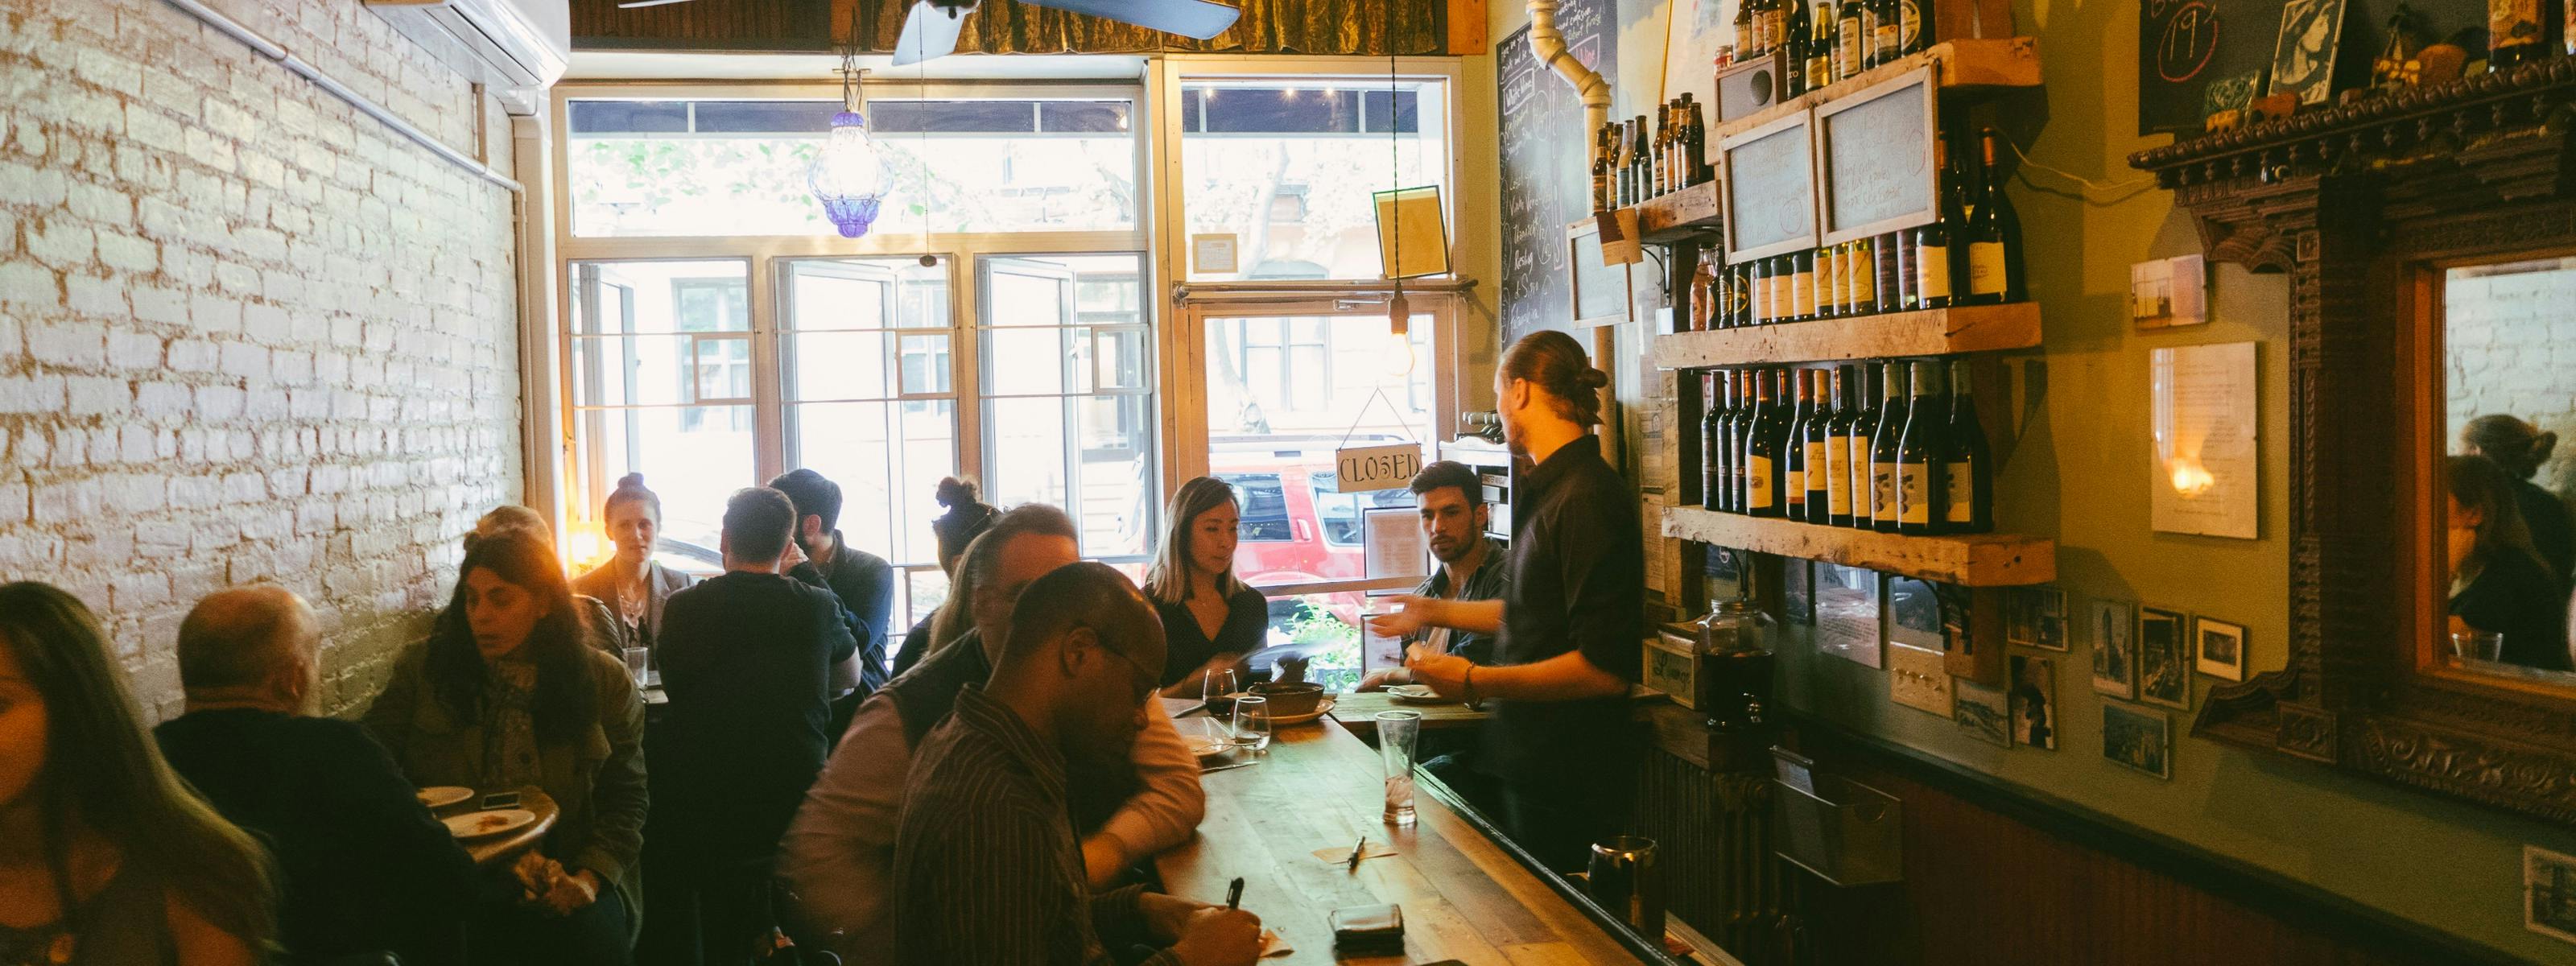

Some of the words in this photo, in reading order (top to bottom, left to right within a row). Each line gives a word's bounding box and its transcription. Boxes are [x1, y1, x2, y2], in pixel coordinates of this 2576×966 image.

[1505, 85, 1520, 108] White
[1520, 75, 1533, 94] Wine
[1340, 453, 1420, 483] CLOSED
